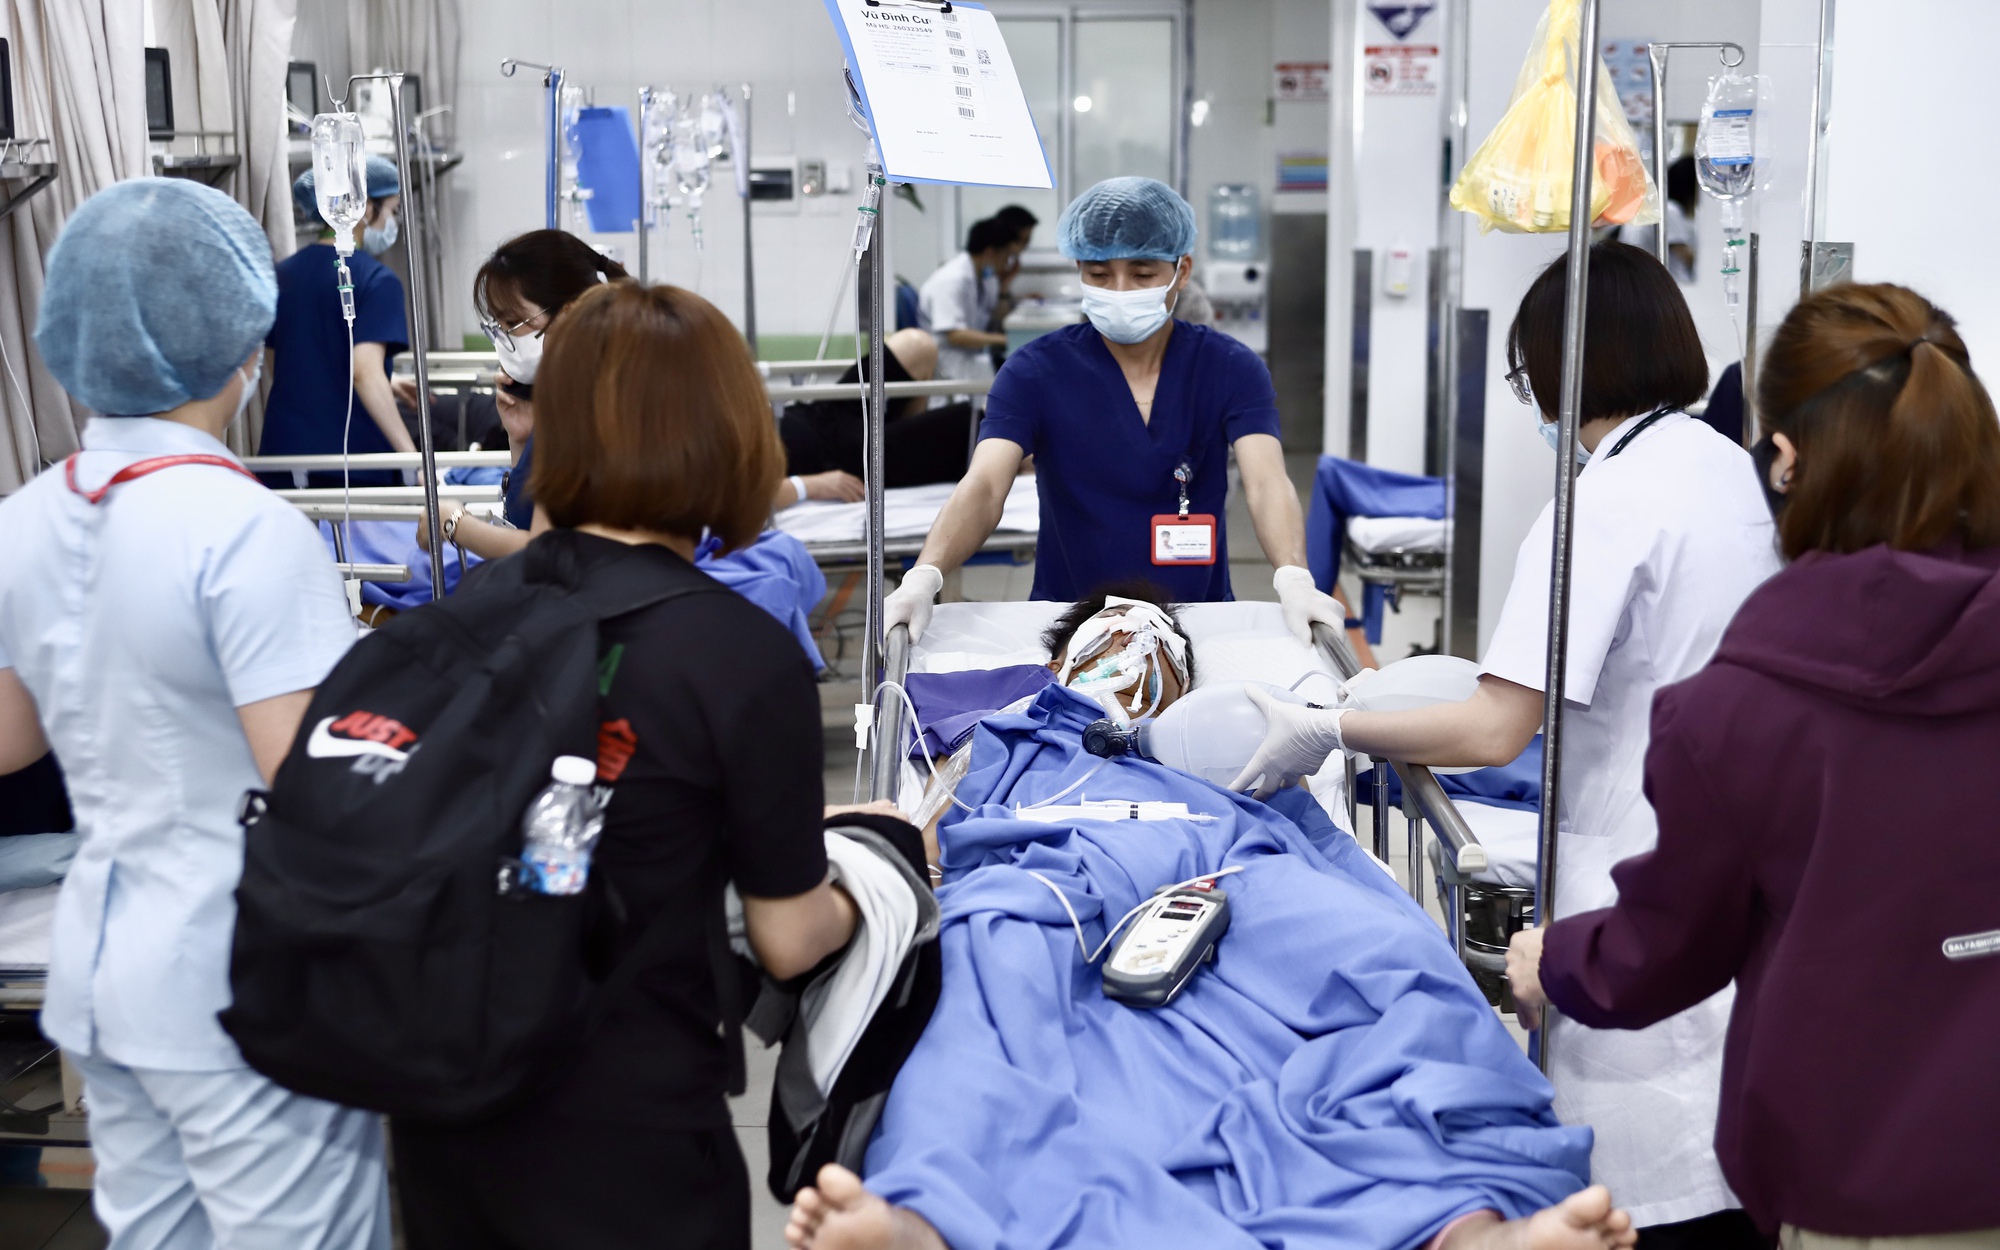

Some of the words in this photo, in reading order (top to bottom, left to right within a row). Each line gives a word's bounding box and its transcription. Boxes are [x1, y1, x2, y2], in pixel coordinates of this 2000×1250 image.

[861, 10, 879, 20] Vũ
[881, 12, 910, 22] Đình
[330, 709, 418, 749] JUST
